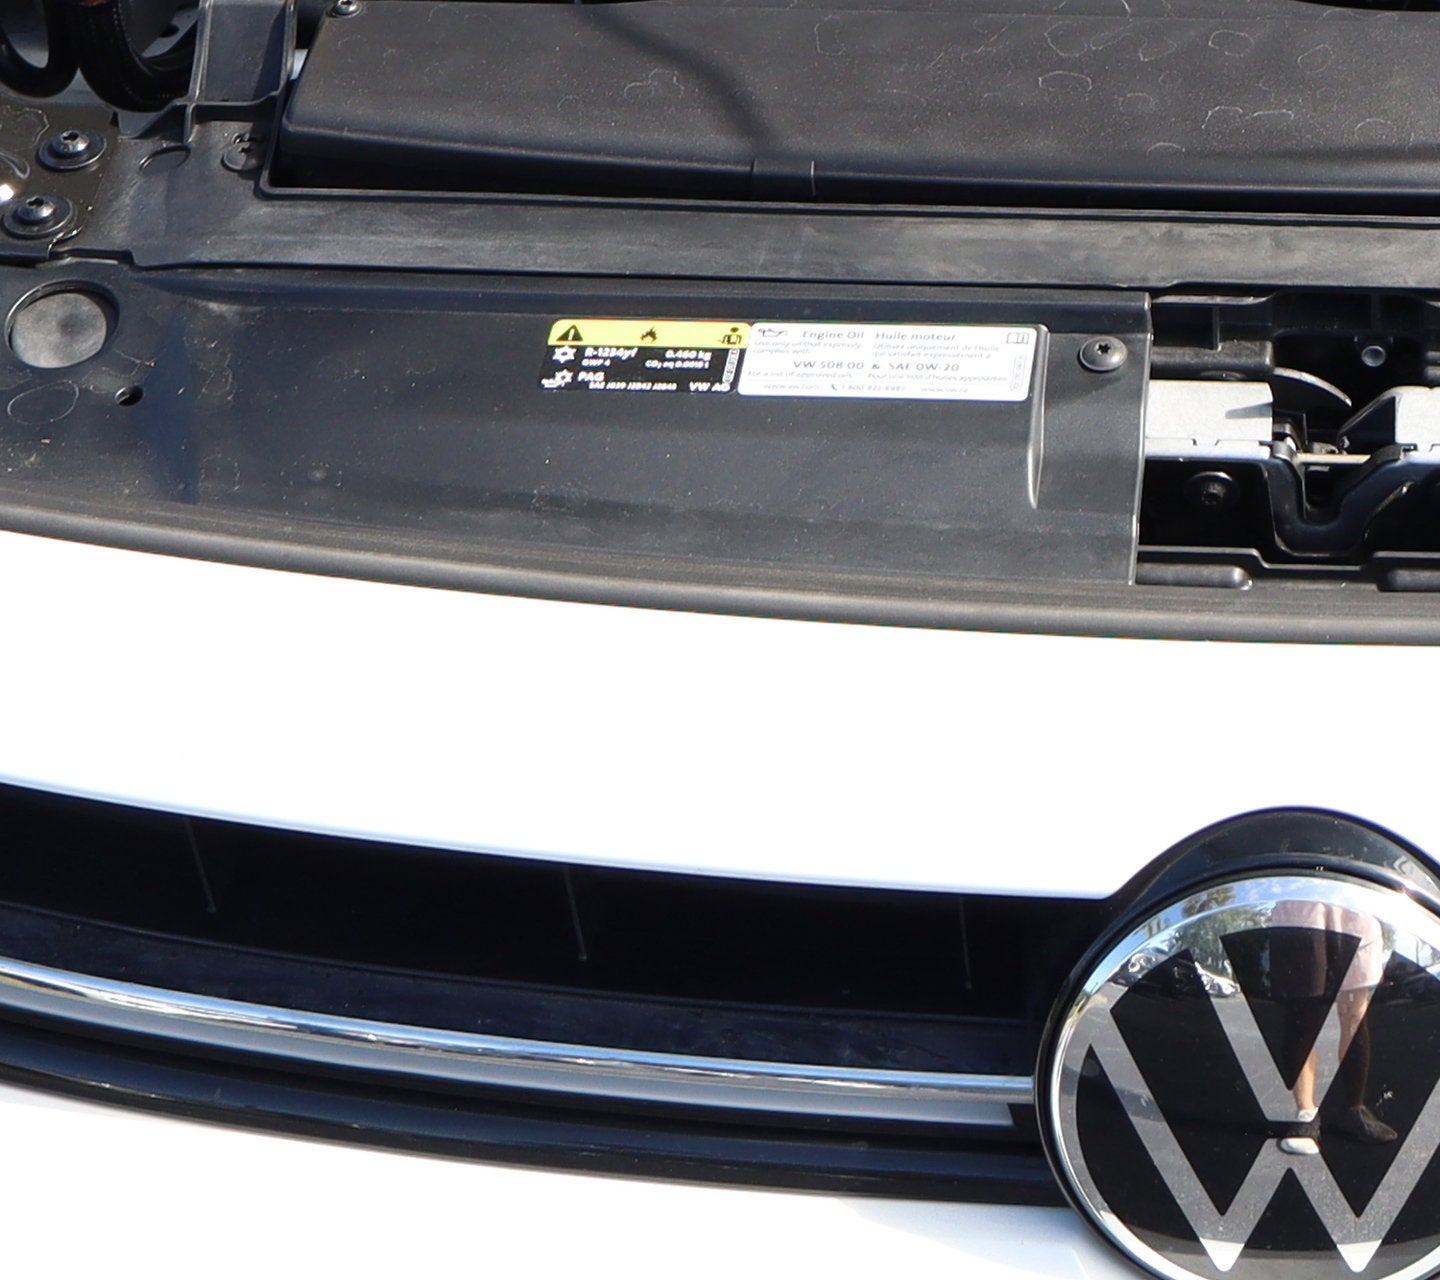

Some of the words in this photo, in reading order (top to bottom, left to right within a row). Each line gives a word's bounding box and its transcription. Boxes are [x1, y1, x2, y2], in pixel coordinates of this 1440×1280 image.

[802, 329, 844, 340] Engine
[846, 329, 865, 339] Oil
[874, 330, 907, 341] Huile
[910, 332, 956, 341] moteur
[698, 350, 712, 362] kg
[793, 360, 815, 369] VW
[819, 360, 843, 370] 508
[846, 360, 865, 370] 00
[888, 362, 912, 371] SAE
[577, 371, 605, 382] PAG
[688, 382, 710, 391] VW
[711, 382, 731, 392] AG
